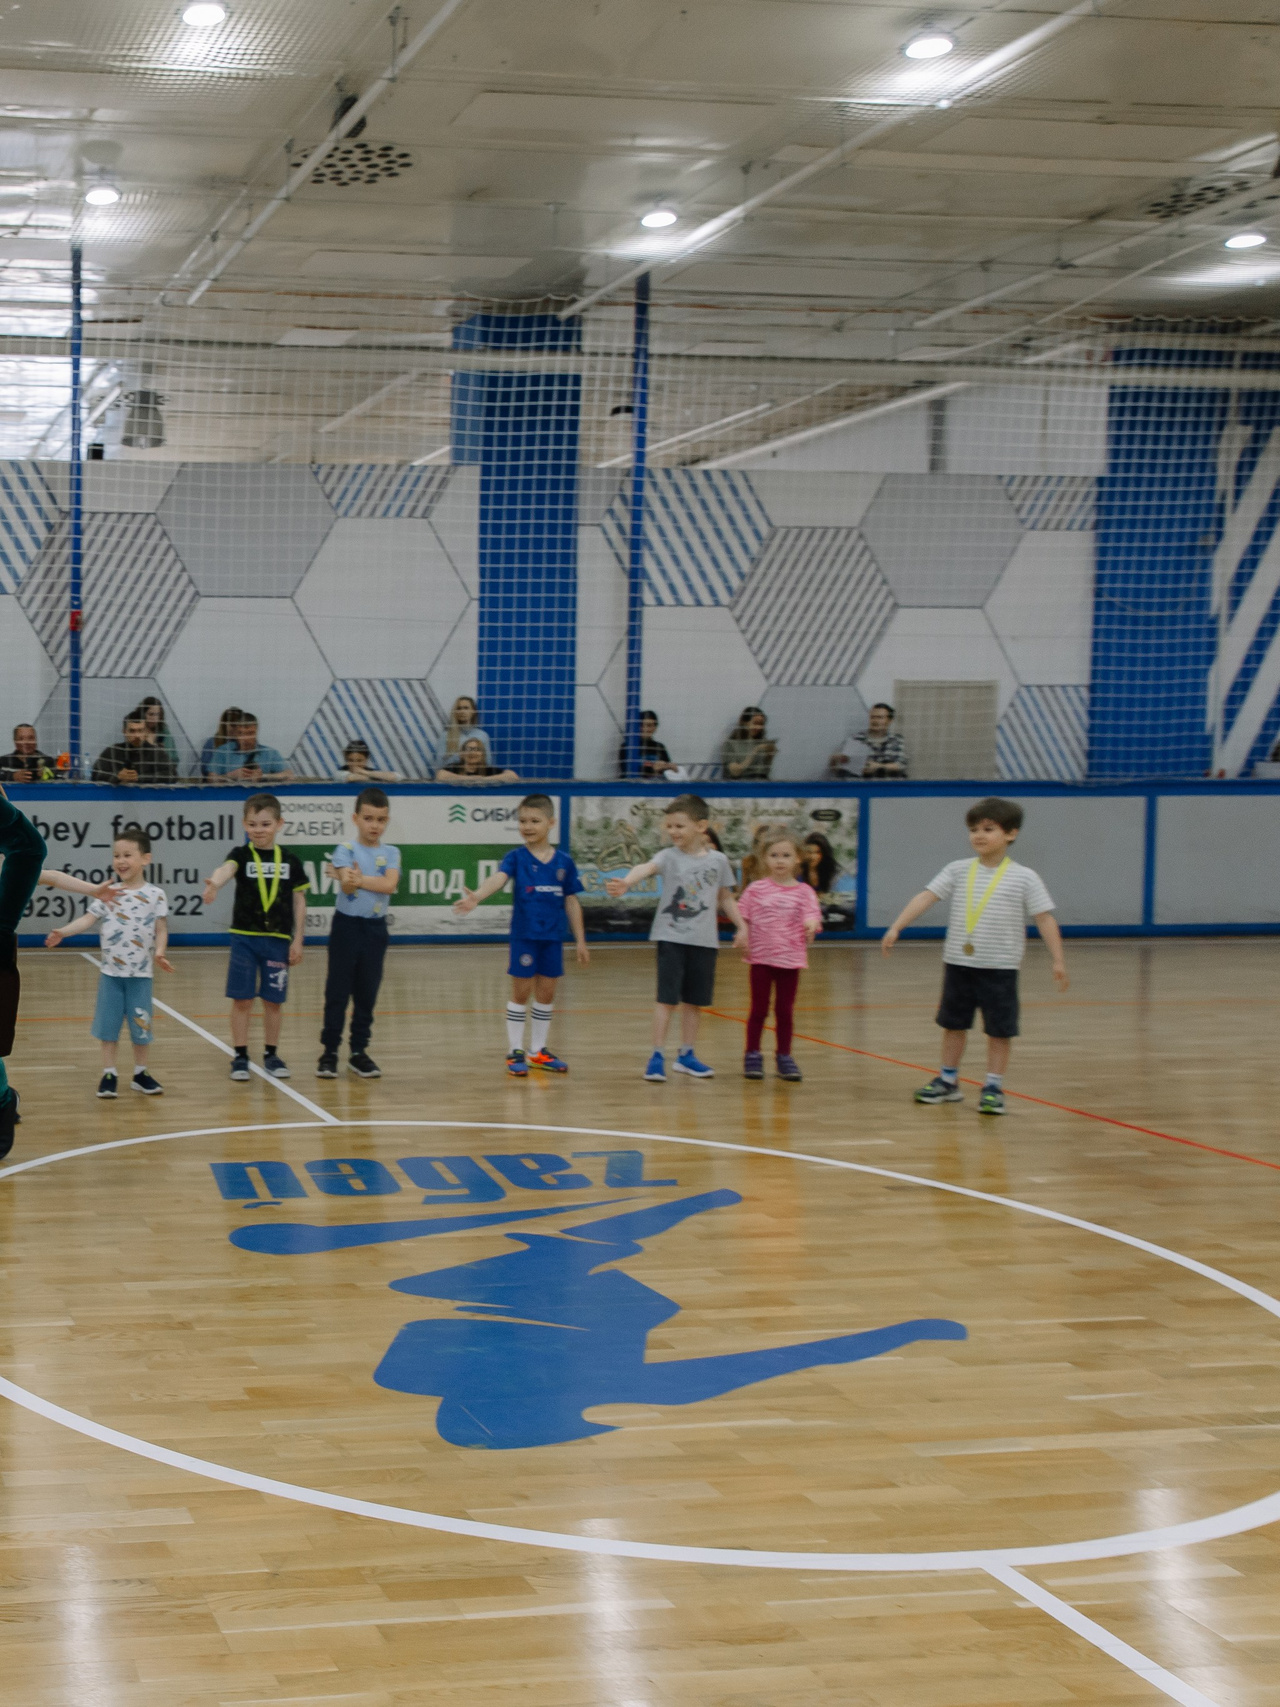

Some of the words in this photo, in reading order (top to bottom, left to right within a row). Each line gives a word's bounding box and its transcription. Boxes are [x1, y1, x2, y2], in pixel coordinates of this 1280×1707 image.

[32, 814, 234, 848] bey_fotball
[471, 808, 519, 823] СИБИ
[409, 868, 468, 900] под
